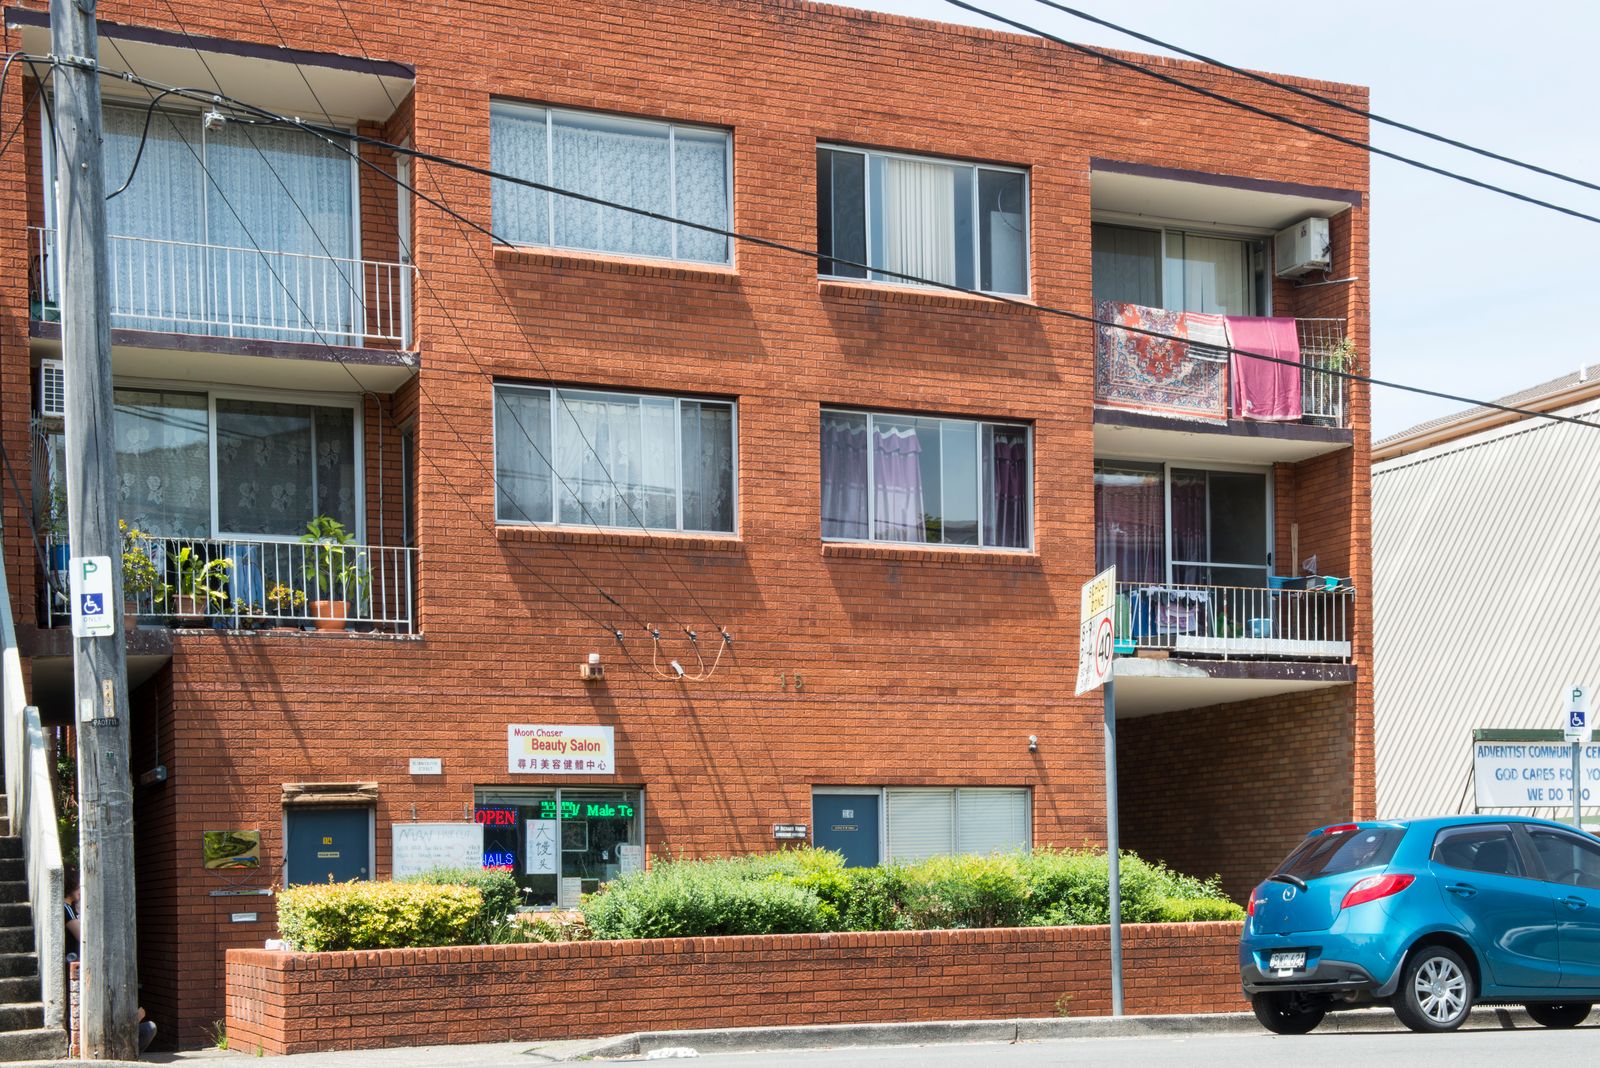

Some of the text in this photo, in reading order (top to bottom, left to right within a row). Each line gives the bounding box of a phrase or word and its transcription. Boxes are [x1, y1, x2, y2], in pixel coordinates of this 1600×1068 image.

[83, 562, 97, 580] P
[1098, 632, 1110, 662] 40
[514, 728, 563, 737] Moon Chaser
[531, 738, 600, 754] Beauty Salon
[1477, 745, 1526, 758] ADVENTIST
[1528, 745, 1582, 758] COMMUNI
[1495, 768, 1518, 781] GOD
[1522, 767, 1555, 781] CARES
[1560, 767, 1573, 781] FO
[1527, 788, 1590, 801] WE DO TO
[587, 803, 615, 817] Male
[475, 810, 515, 825] OPEN
